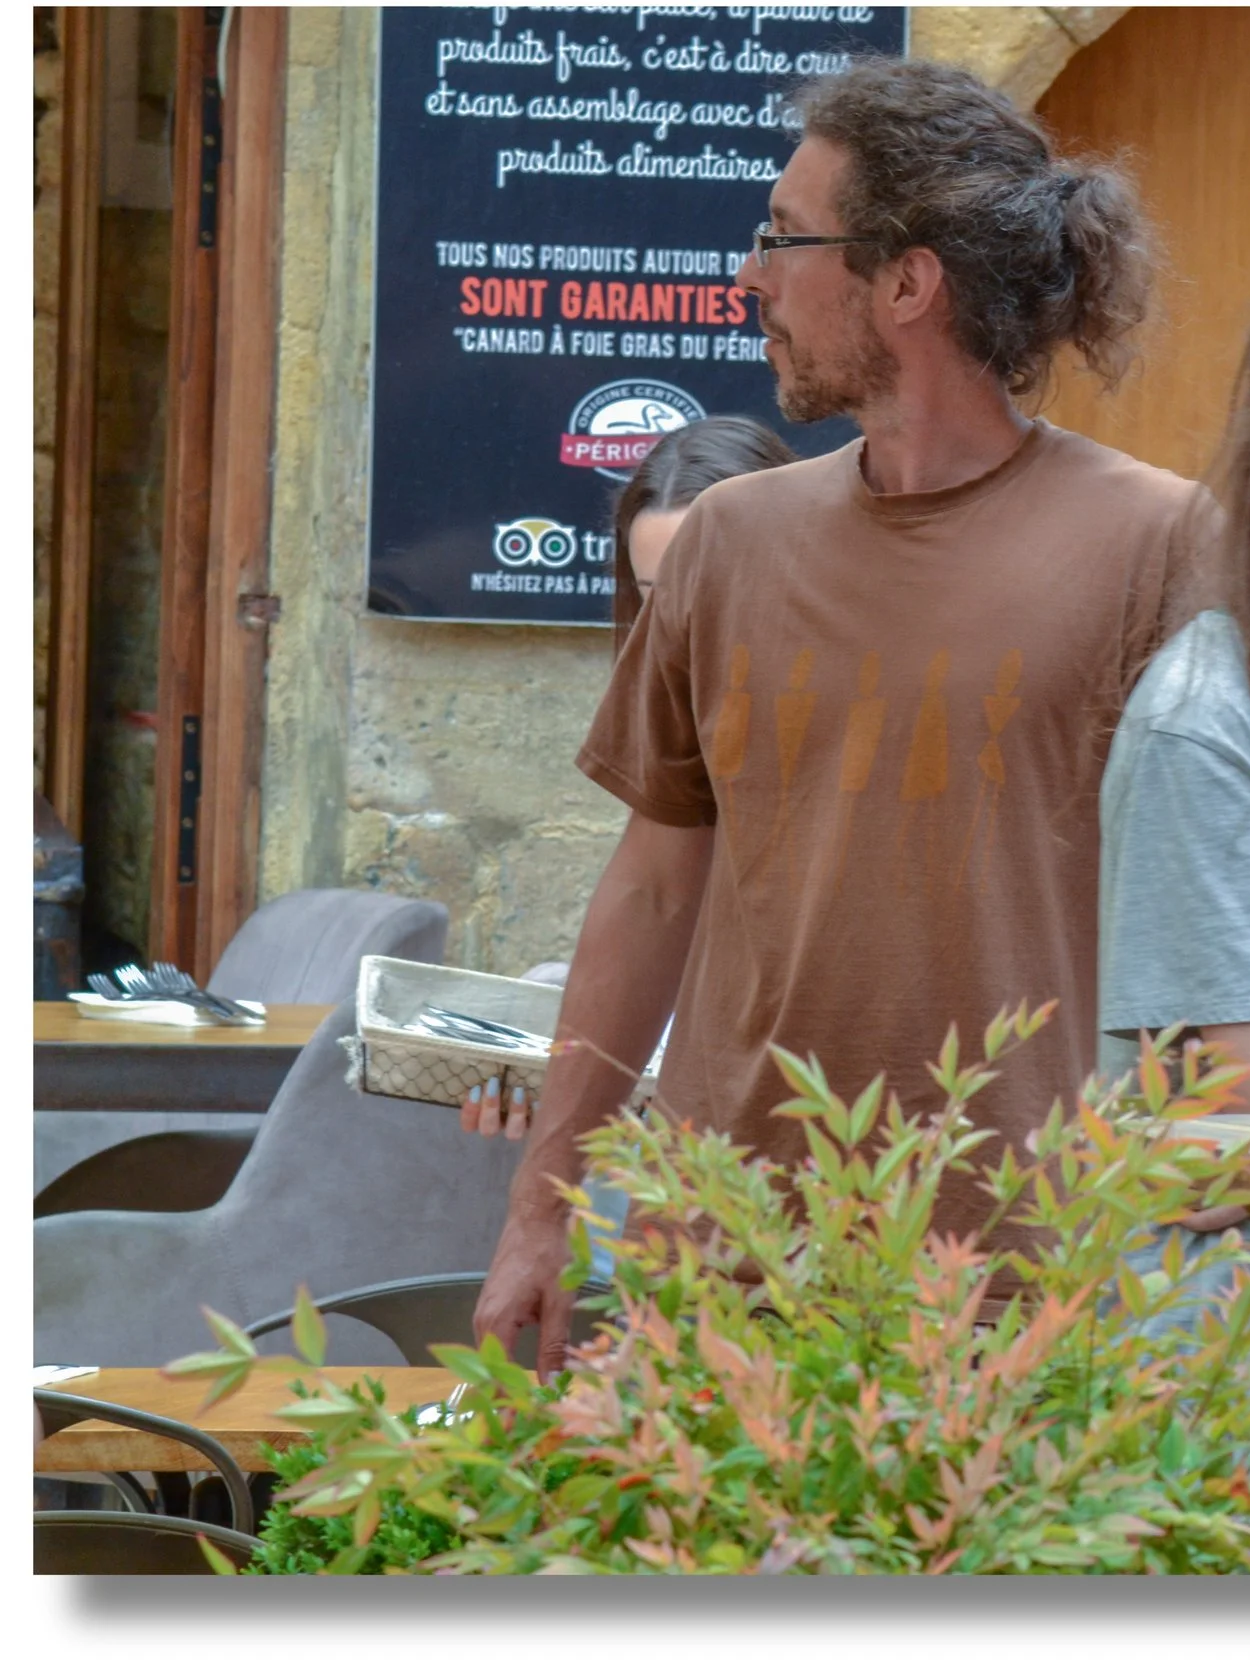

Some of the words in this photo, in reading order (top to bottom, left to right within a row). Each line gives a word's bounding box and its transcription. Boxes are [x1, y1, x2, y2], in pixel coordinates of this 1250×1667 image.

[437, 29, 553, 77] produits
[556, 30, 633, 83] frais,
[642, 34, 709, 70] c'est
[709, 40, 731, 72] à
[734, 38, 793, 73] dire
[425, 79, 456, 116] et
[456, 92, 524, 118] sans
[526, 87, 688, 141] assemblage
[690, 103, 754, 125] avec
[757, 93, 805, 129] d'a
[496, 139, 613, 188] produits
[436, 240, 488, 267] TOUS
[492, 243, 534, 269] NOS
[539, 245, 638, 273] PRODUITS
[641, 249, 722, 276] AUTOUR
[460, 276, 548, 318] SONT
[561, 280, 748, 325] GARANTIES
[550, 323, 565, 355] À
[570, 331, 616, 357] FOIE
[620, 332, 675, 359] GRAS
[680, 334, 709, 361] DU
[577, 385, 631, 429] ORIGINE
[574, 440, 648, 462] PÉRIG
[471, 569, 542, 594] N'HÉSITEZ
[544, 575, 575, 594] PAS
[576, 571, 589, 595] À
